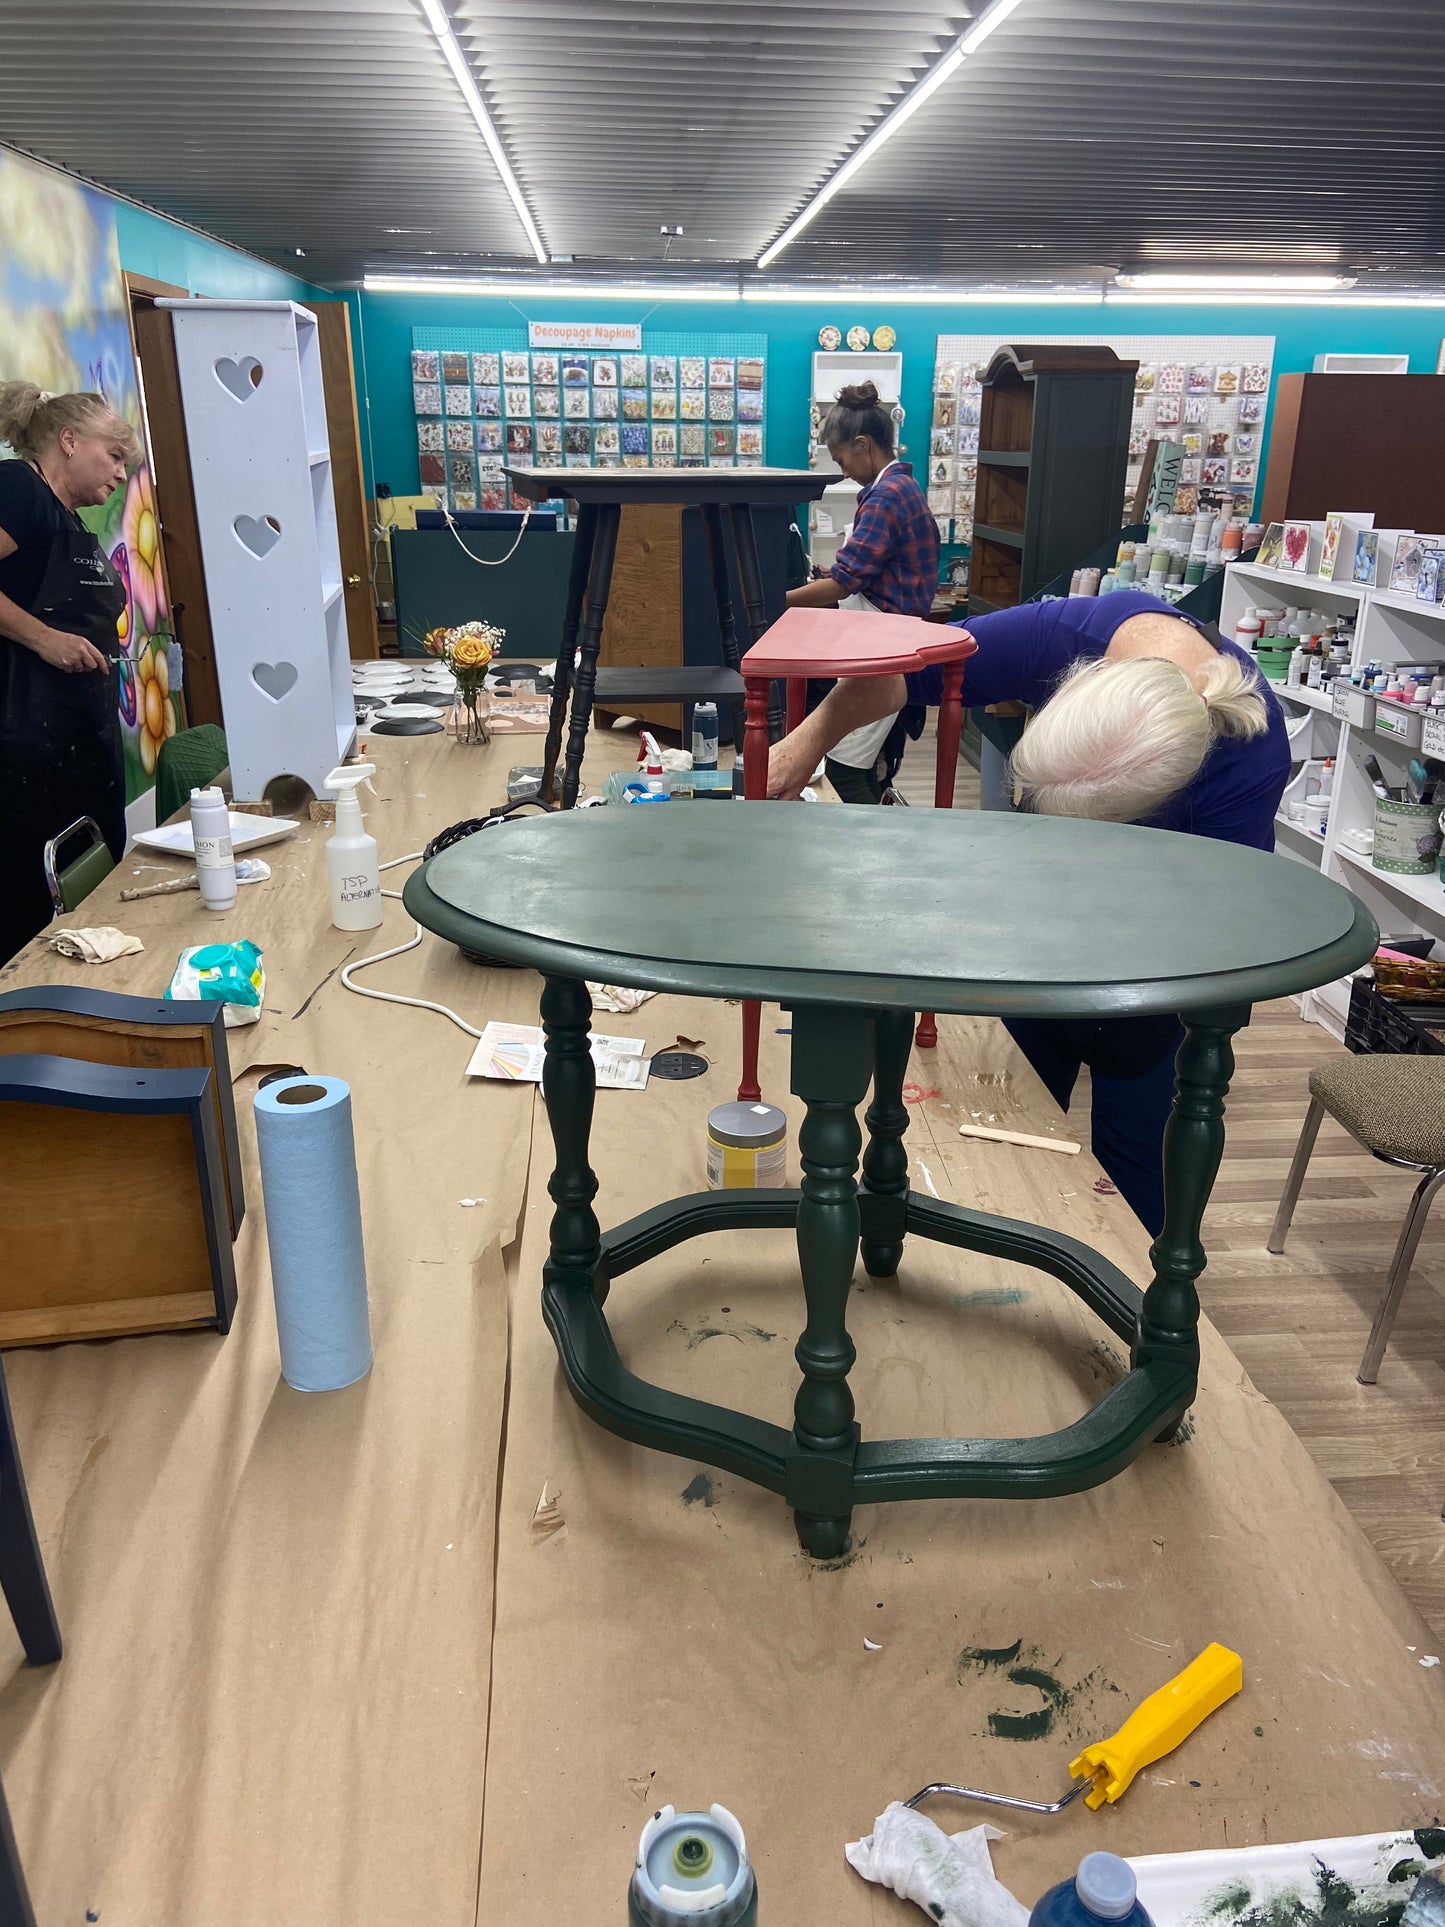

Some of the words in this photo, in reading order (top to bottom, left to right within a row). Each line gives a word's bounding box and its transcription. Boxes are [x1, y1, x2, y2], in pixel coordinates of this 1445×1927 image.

[534, 325, 592, 341] Decoupage
[594, 326, 636, 341] Napkins
[1156, 457, 1181, 514] WELC
[342, 875, 368, 891] TSP
